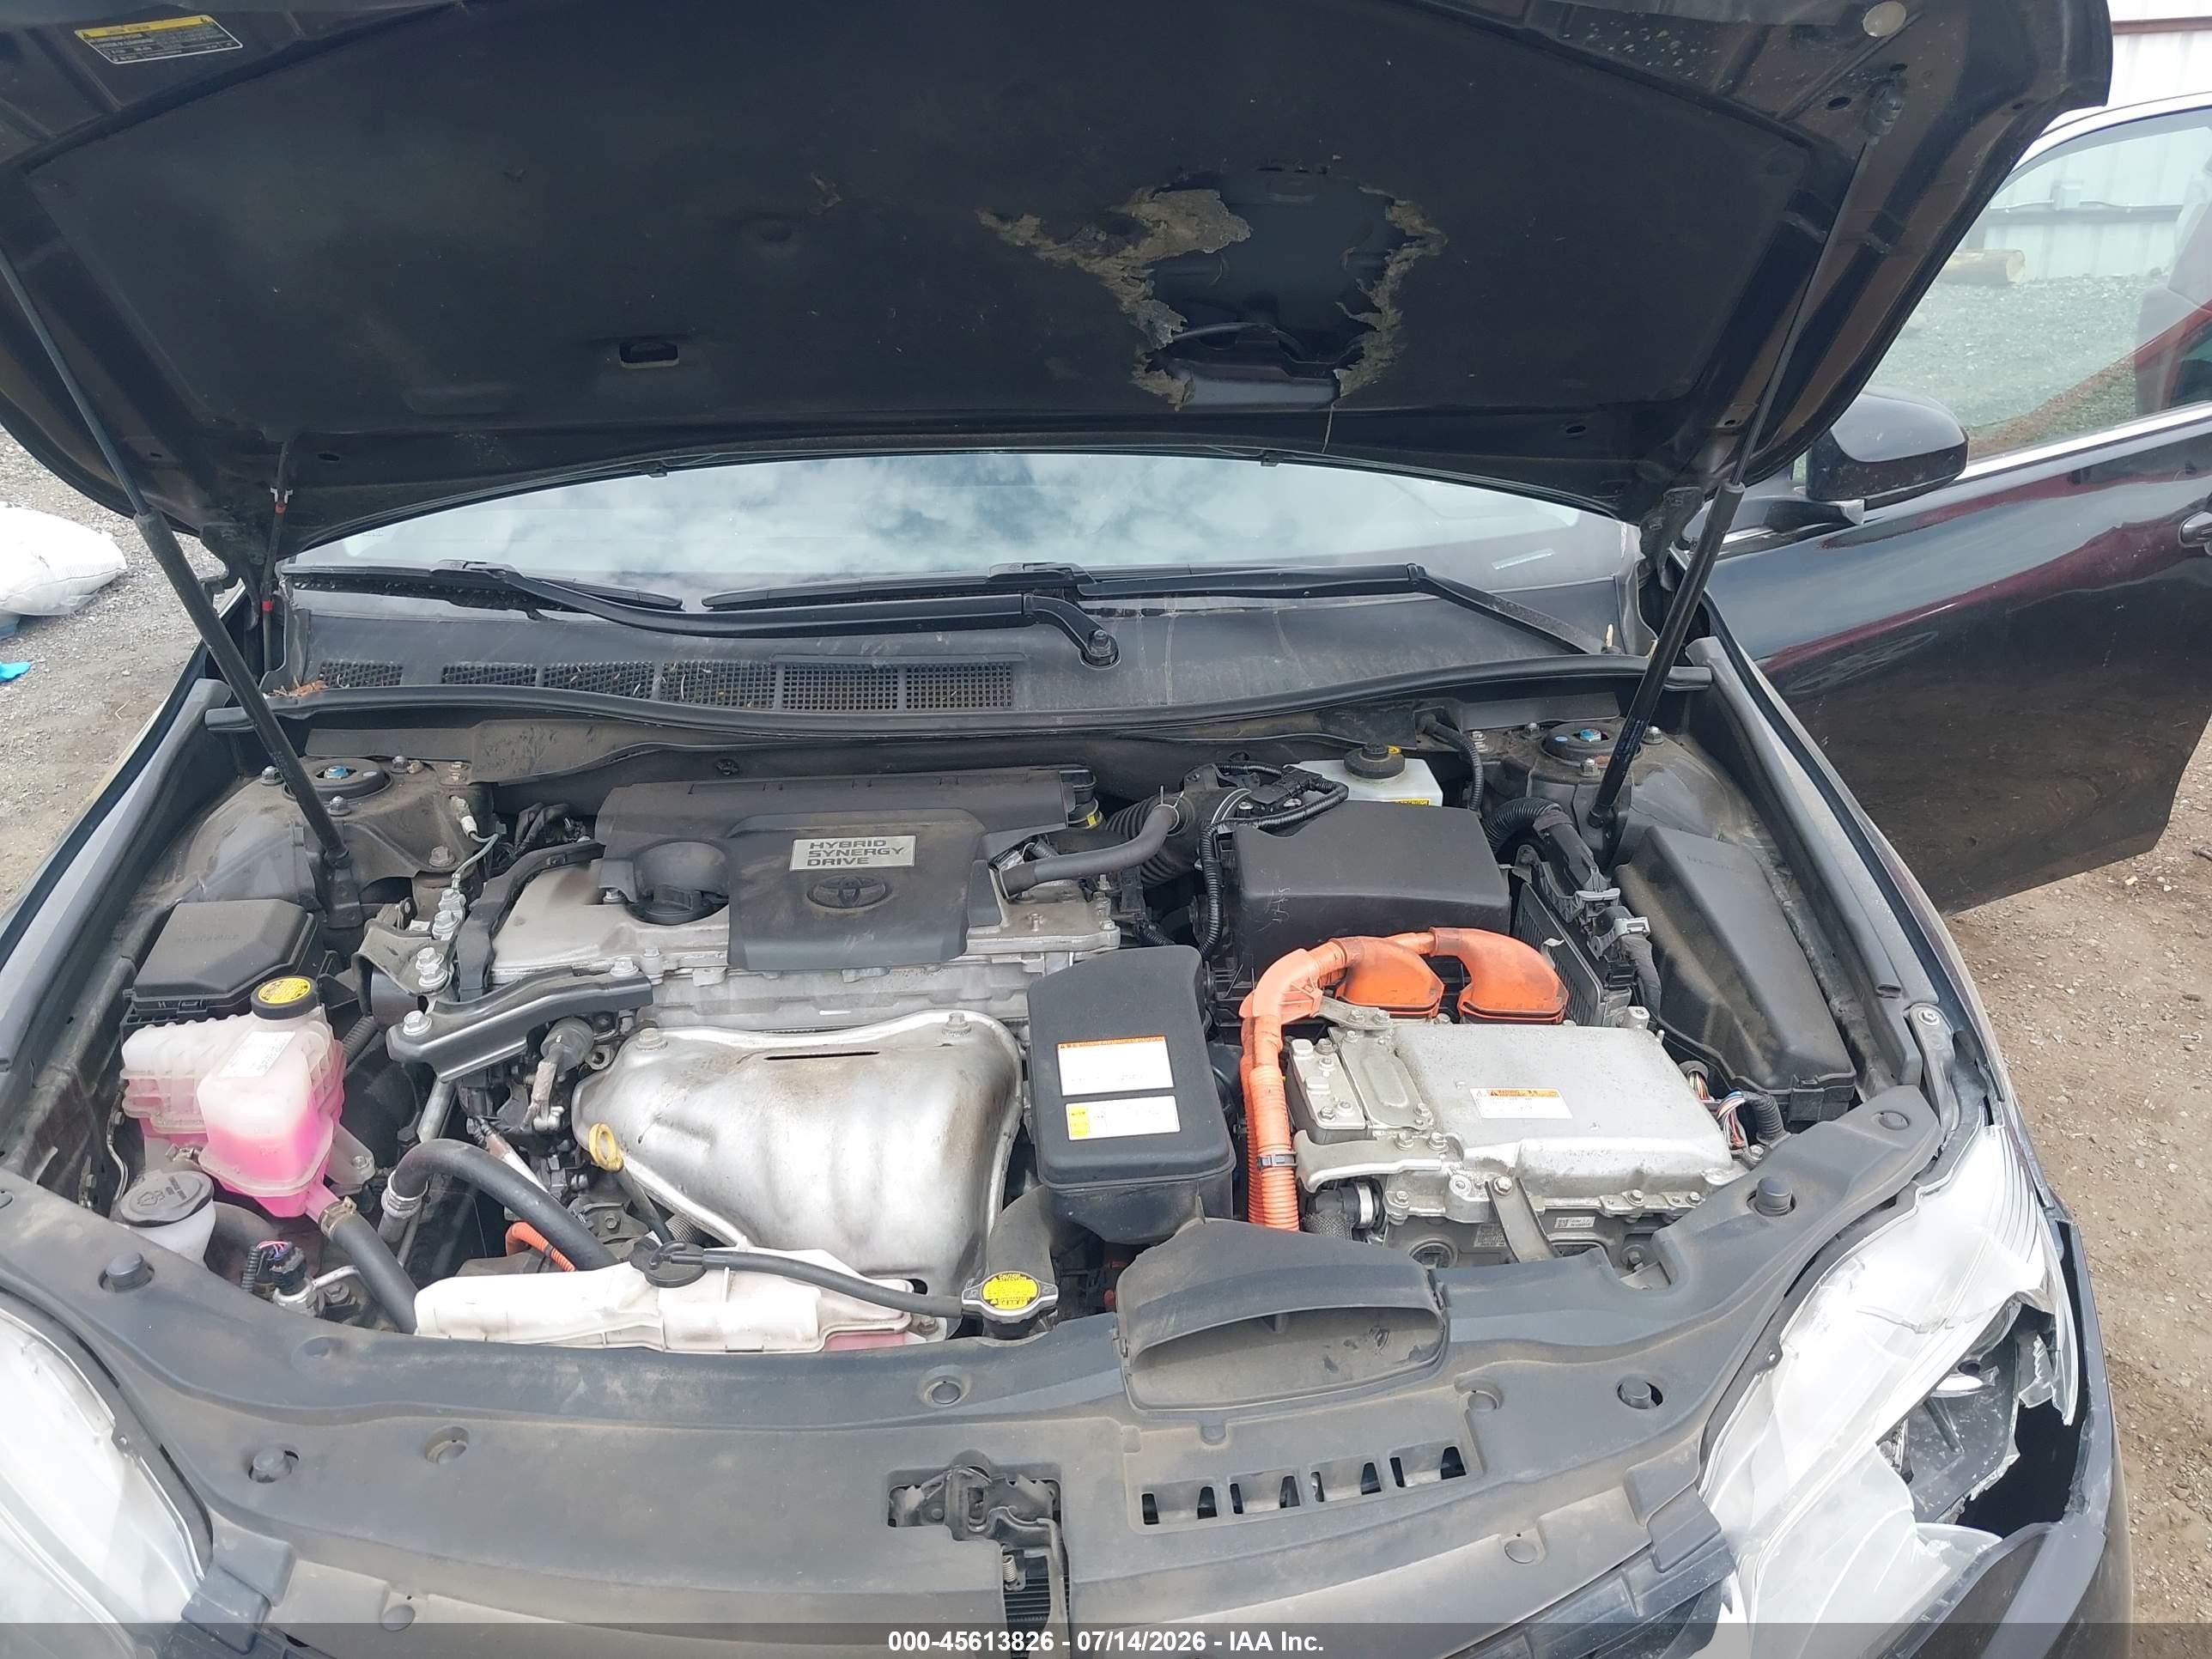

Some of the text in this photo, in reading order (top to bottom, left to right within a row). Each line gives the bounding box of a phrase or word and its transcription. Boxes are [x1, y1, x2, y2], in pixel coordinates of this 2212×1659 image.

[811, 841, 886, 849] HYBRID
[808, 848, 904, 857] SYNERGY
[807, 858, 869, 866] DRIVE
